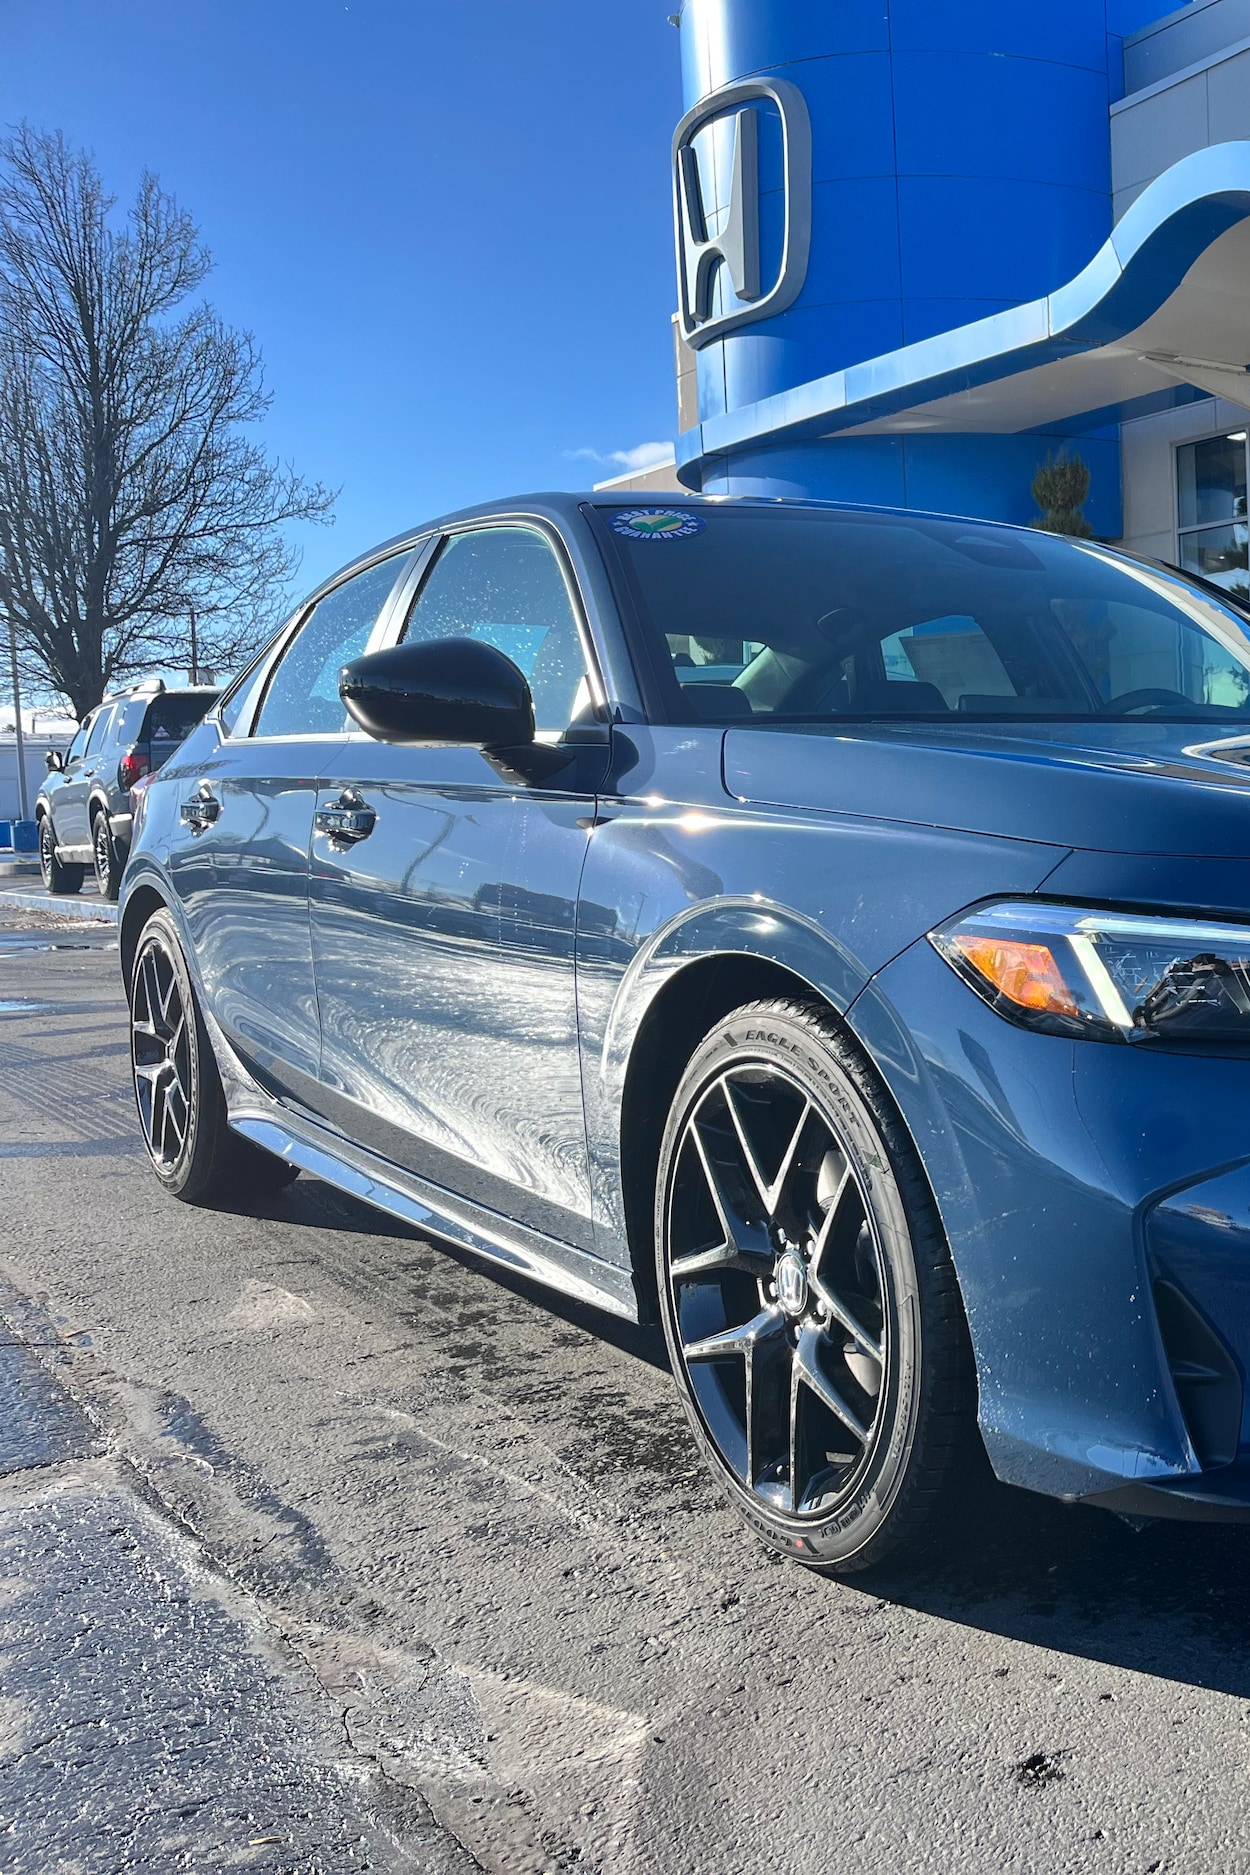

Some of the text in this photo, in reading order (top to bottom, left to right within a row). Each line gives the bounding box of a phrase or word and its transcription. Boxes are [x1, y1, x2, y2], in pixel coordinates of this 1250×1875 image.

[616, 509, 697, 522] BEST PRICE
[613, 525, 698, 539] GUARANTEE
[745, 1029, 803, 1057] EAGLE
[806, 1056, 862, 1129] SPORT
